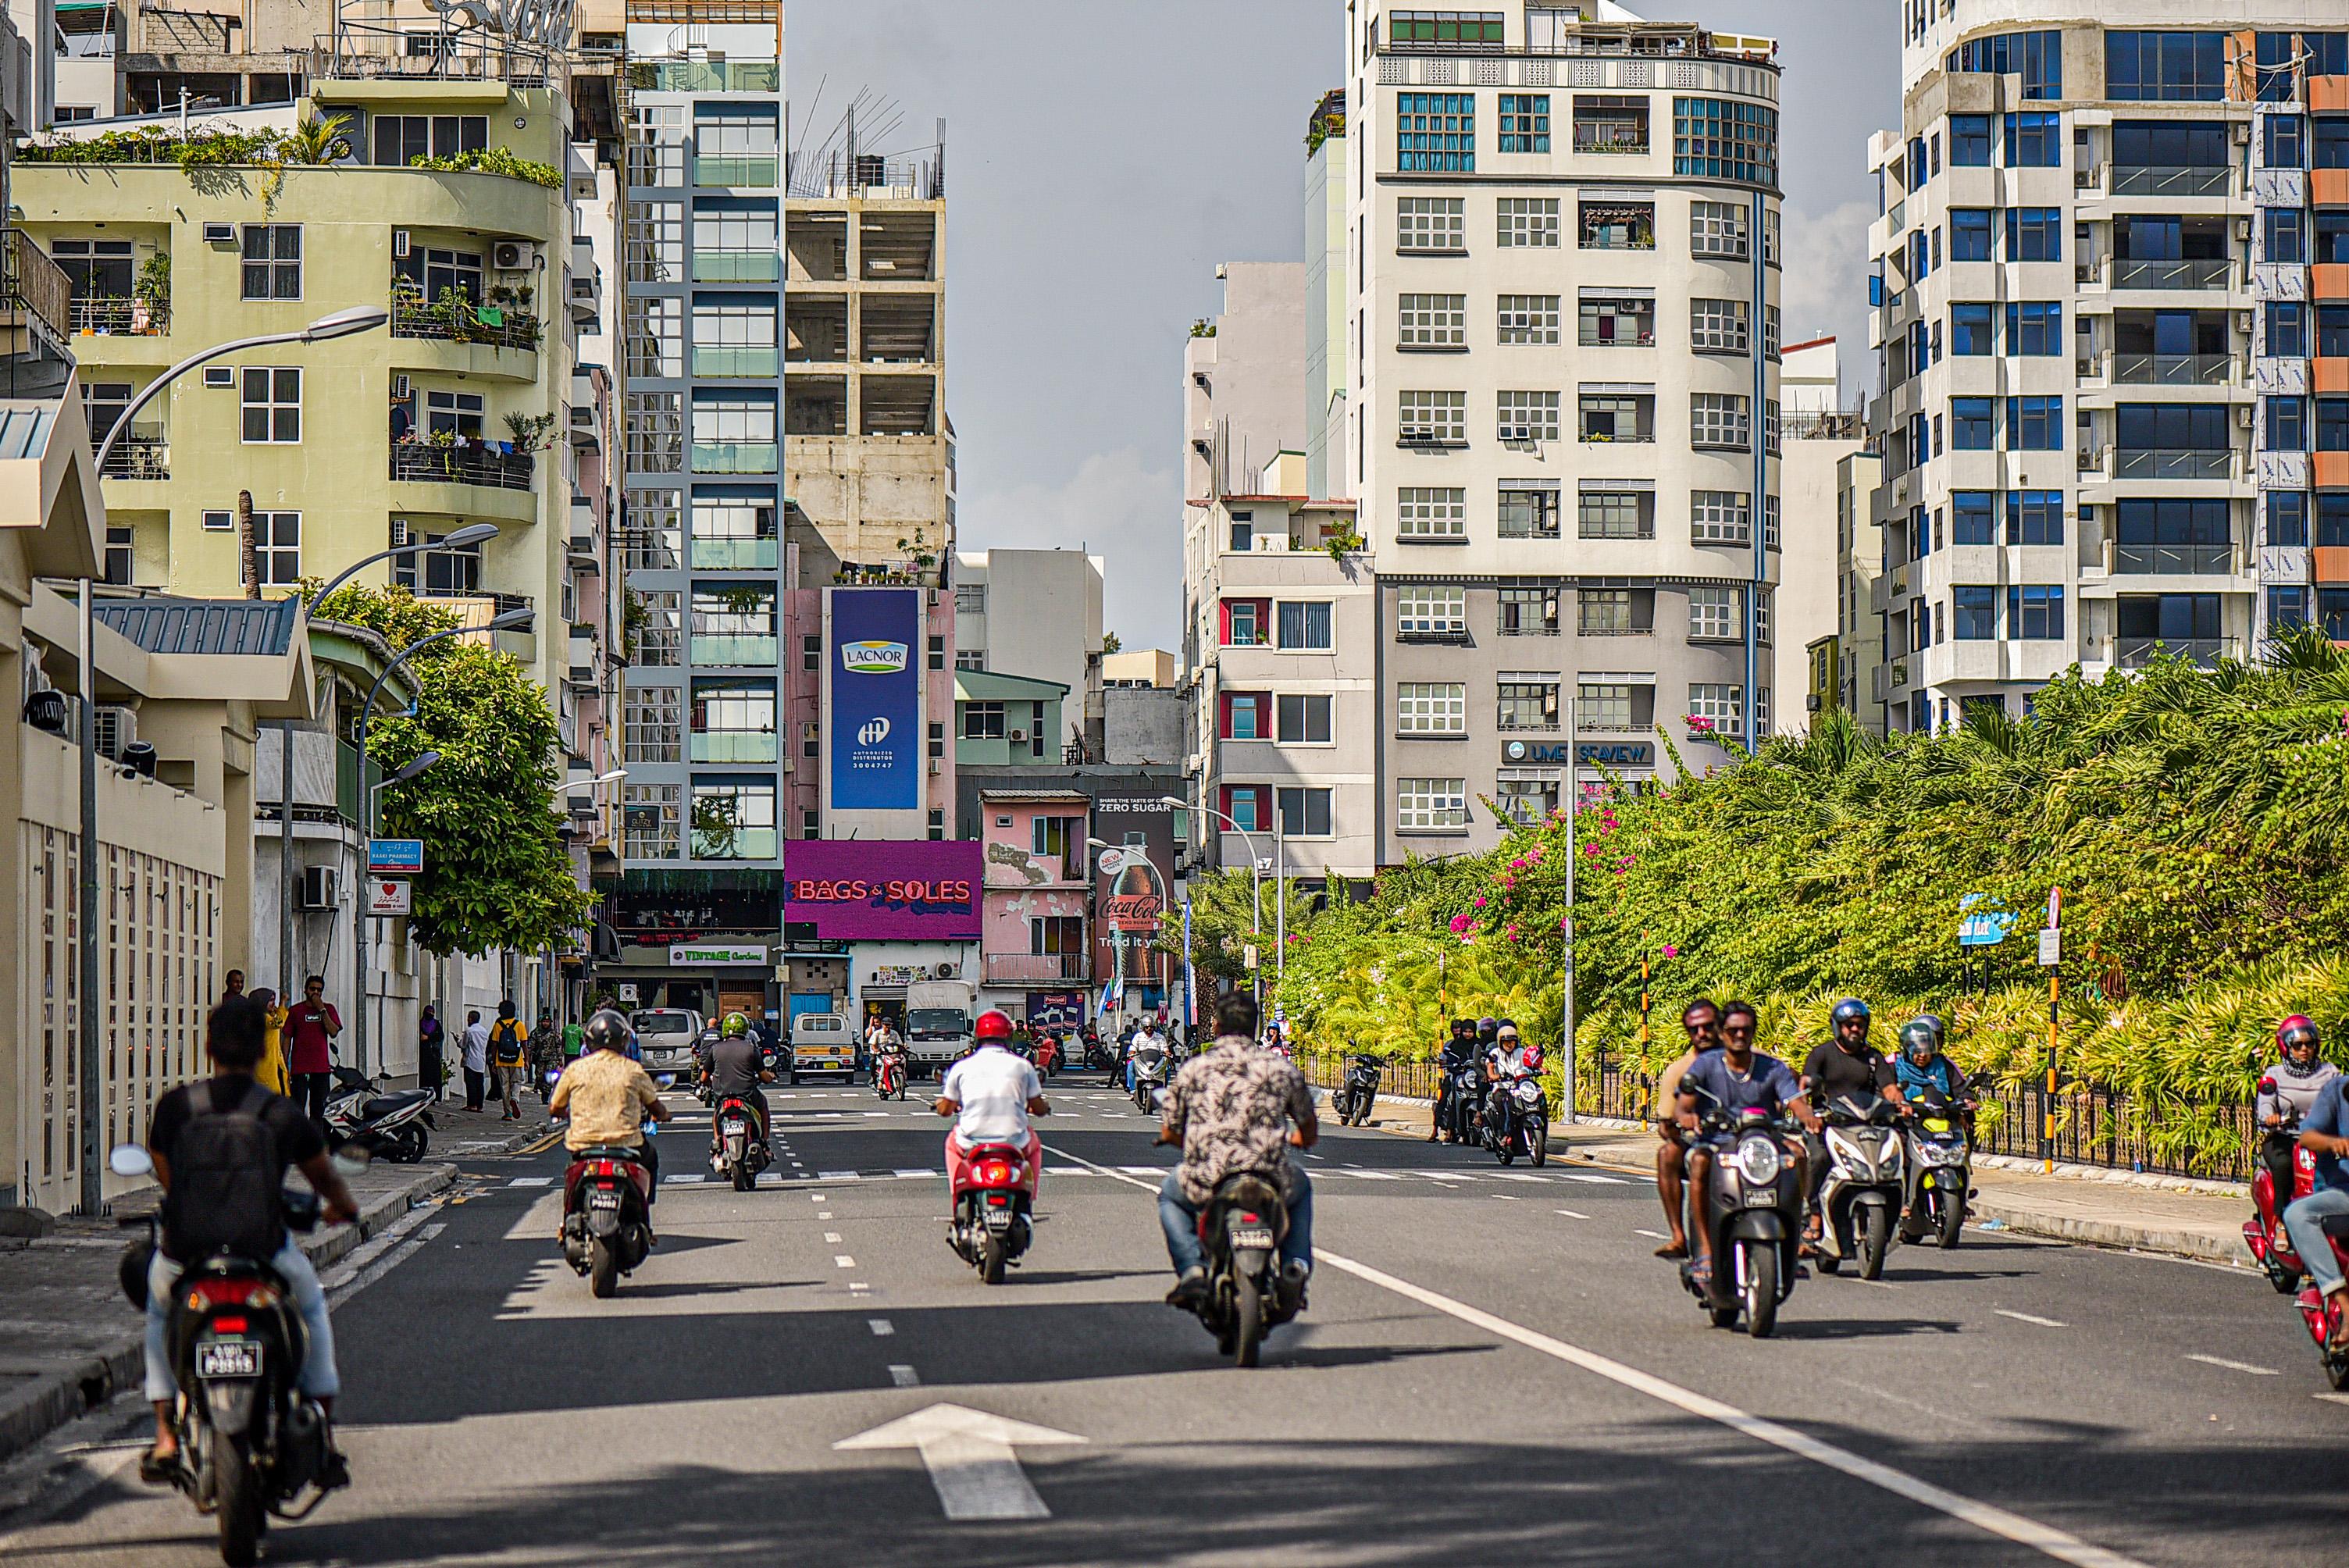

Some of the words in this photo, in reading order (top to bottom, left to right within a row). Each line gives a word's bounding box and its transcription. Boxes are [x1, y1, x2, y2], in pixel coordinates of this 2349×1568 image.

[847, 650, 902, 663] LACNOR
[1531, 745, 1569, 761] UME
[1579, 745, 1646, 762] SEAVIEW
[1099, 804, 1129, 812] ZERO
[1132, 804, 1171, 812] SUGAR
[1101, 853, 1120, 864] NEW
[799, 880, 867, 900] BAGS
[872, 884, 883, 896] &
[889, 880, 970, 900] SOLES
[1100, 896, 1162, 919] Coca-Col
[1099, 937, 1130, 947] Tried
[1144, 939, 1160, 949] ye
[685, 950, 730, 961] VINTAGE
[732, 952, 763, 961] Gardens
